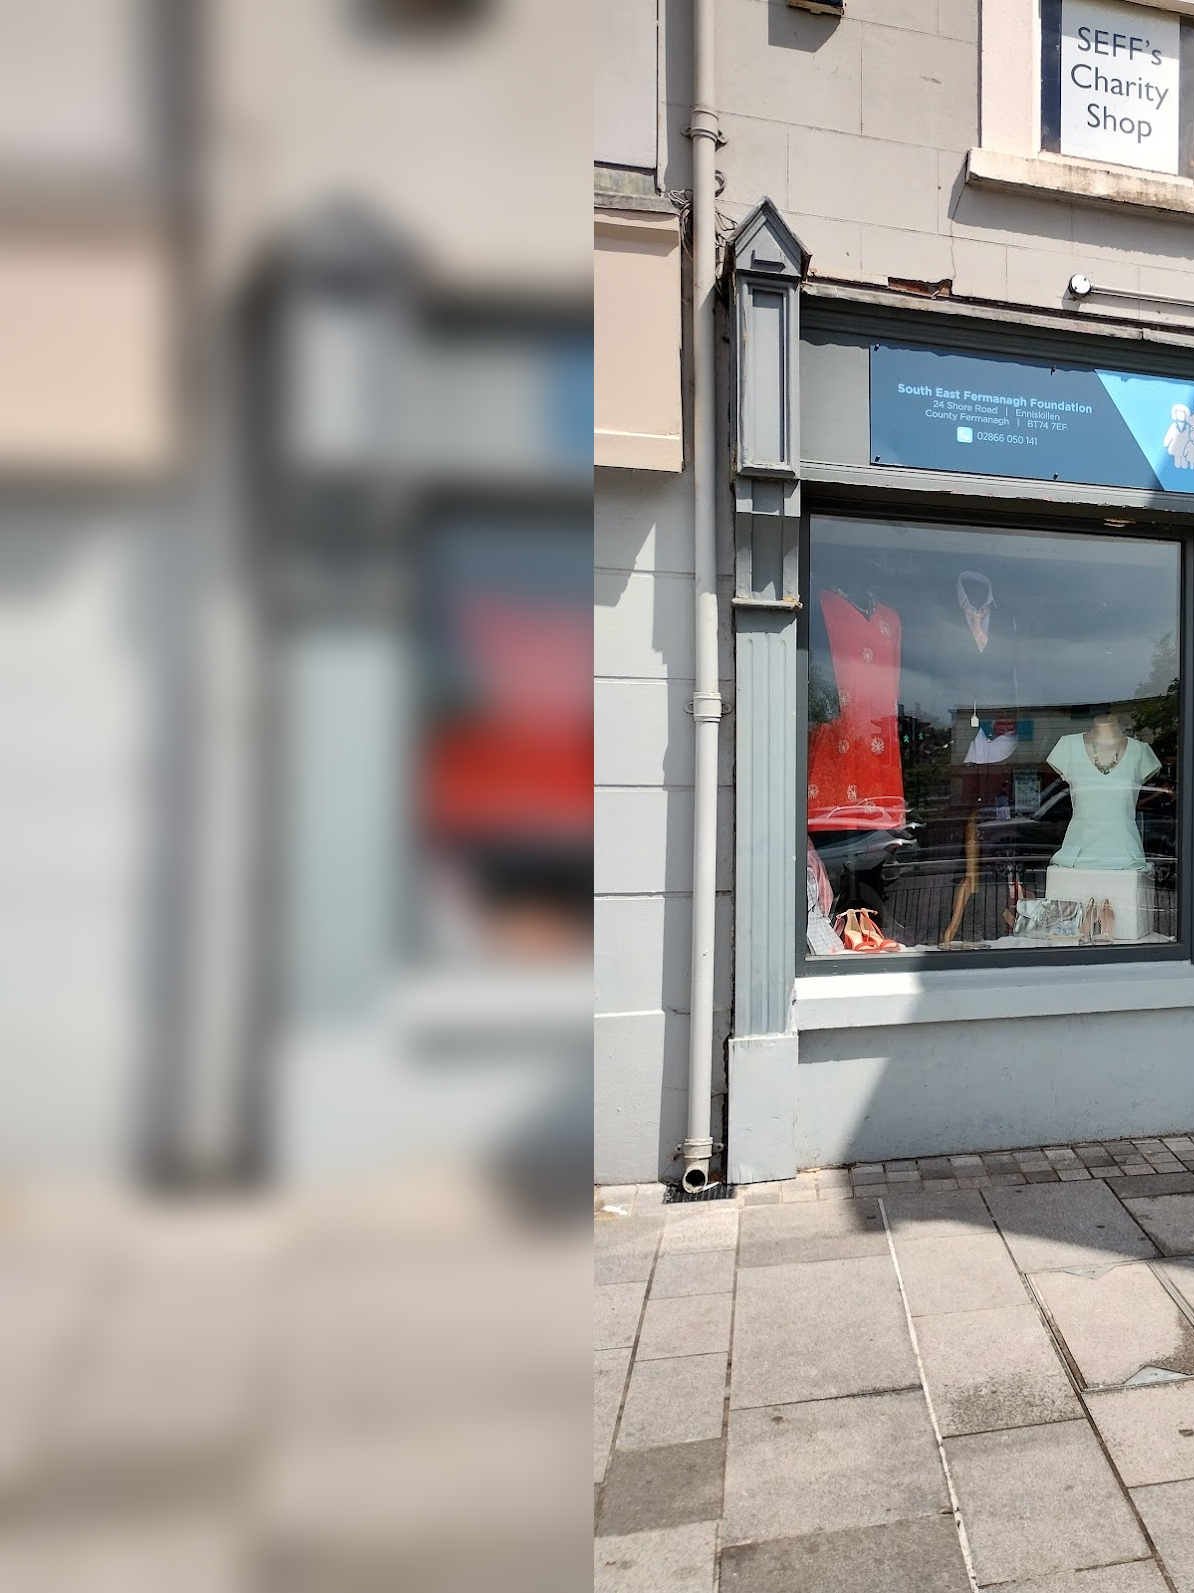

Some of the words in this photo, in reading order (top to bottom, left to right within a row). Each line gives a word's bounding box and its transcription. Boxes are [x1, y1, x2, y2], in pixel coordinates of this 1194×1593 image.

[1077, 26, 1162, 66] SEFF's
[1070, 63, 1169, 110] Charity
[1087, 103, 1152, 144] Shop
[898, 384, 932, 397] South
[936, 388, 960, 399] East
[964, 391, 1027, 407] Fermanagh
[1031, 398, 1093, 414] Foundation
[933, 400, 944, 408] 24
[947, 402, 973, 412] Shore
[975, 404, 998, 414] Road
[1016, 409, 1060, 421] Enniskillen
[925, 409, 958, 420] County
[960, 412, 1009, 425] Fermanagh
[1028, 420, 1049, 429] BT74
[1051, 422, 1067, 431] 7EF
[977, 431, 1004, 443] 02866
[1007, 434, 1024, 444] 050
[1026, 436, 1038, 446] 141
